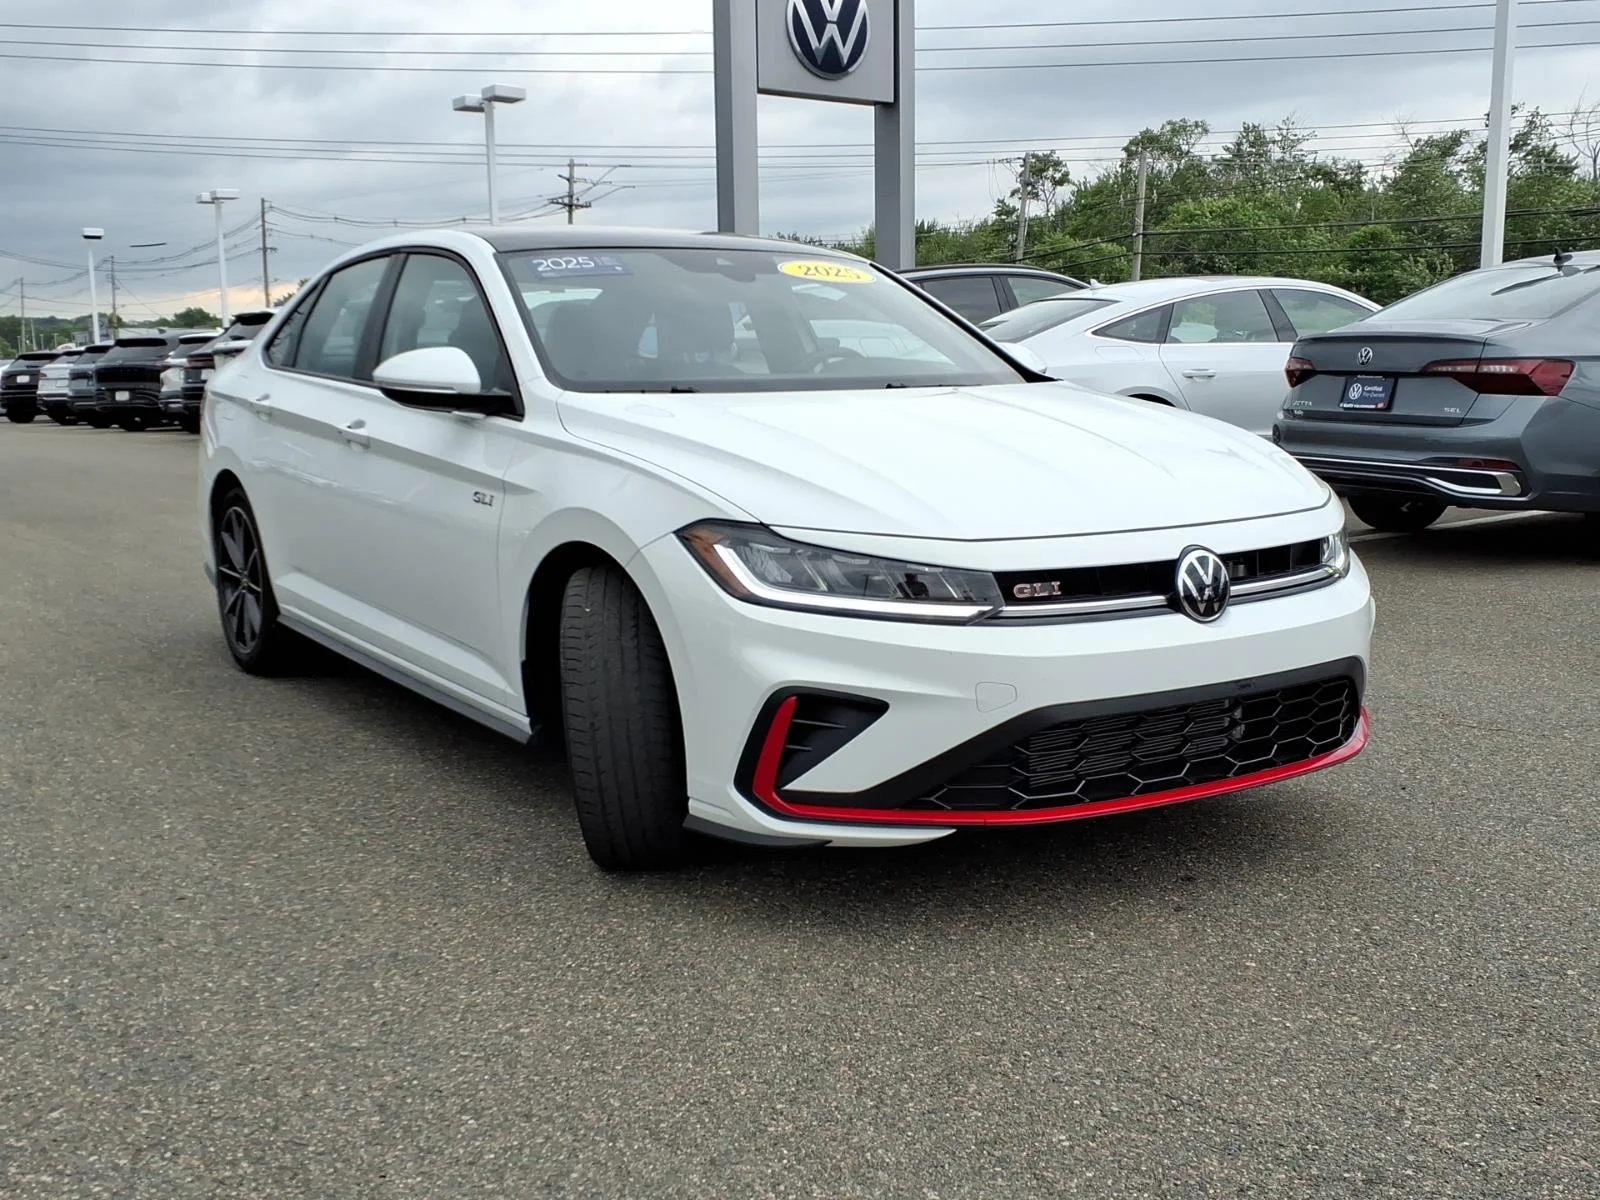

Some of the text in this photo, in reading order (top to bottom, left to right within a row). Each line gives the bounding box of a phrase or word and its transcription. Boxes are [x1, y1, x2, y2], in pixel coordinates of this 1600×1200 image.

[532, 256, 595, 271] 2025
[797, 264, 861, 280] 2025
[1013, 581, 1062, 599] GLI
